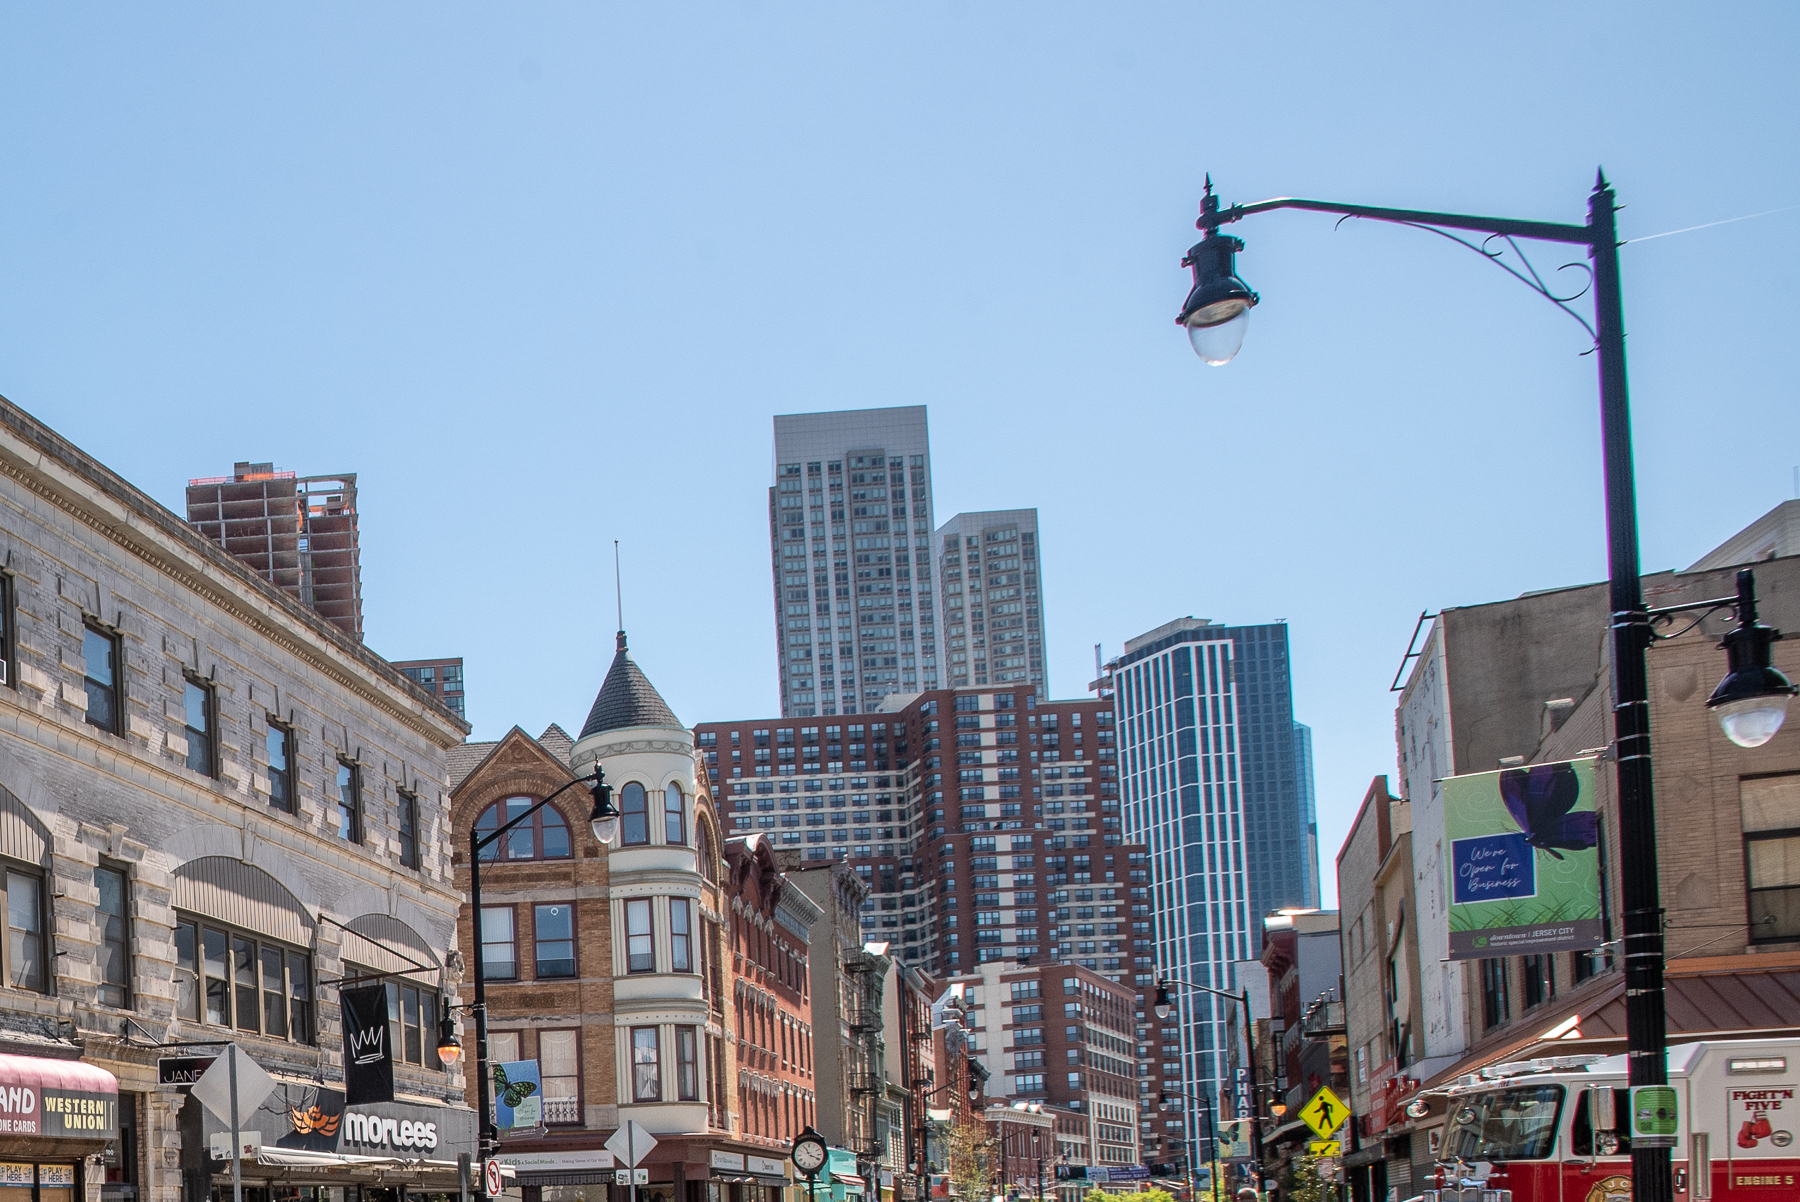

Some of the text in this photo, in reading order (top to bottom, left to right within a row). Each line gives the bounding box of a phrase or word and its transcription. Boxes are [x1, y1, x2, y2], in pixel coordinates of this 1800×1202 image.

[1460, 858, 1519, 878] Open for
[1468, 878, 1521, 892] Business
[1490, 932, 1526, 942] downtown
[1532, 928, 1558, 938] JERSEY
[164, 1070, 202, 1083] JANE
[1732, 1090, 1794, 1100] FIGHT'N
[45, 1096, 104, 1114] WESTERN
[1744, 1100, 1782, 1110] FIVE
[14, 1120, 36, 1133] CARDS
[64, 1114, 104, 1130] UNION
[6, 1165, 22, 1174] PLAY
[48, 1166, 63, 1174] PLAY
[6, 1174, 22, 1182] HERE
[48, 1174, 63, 1182] HERE
[1736, 1176, 1794, 1186] ENGINE 5
